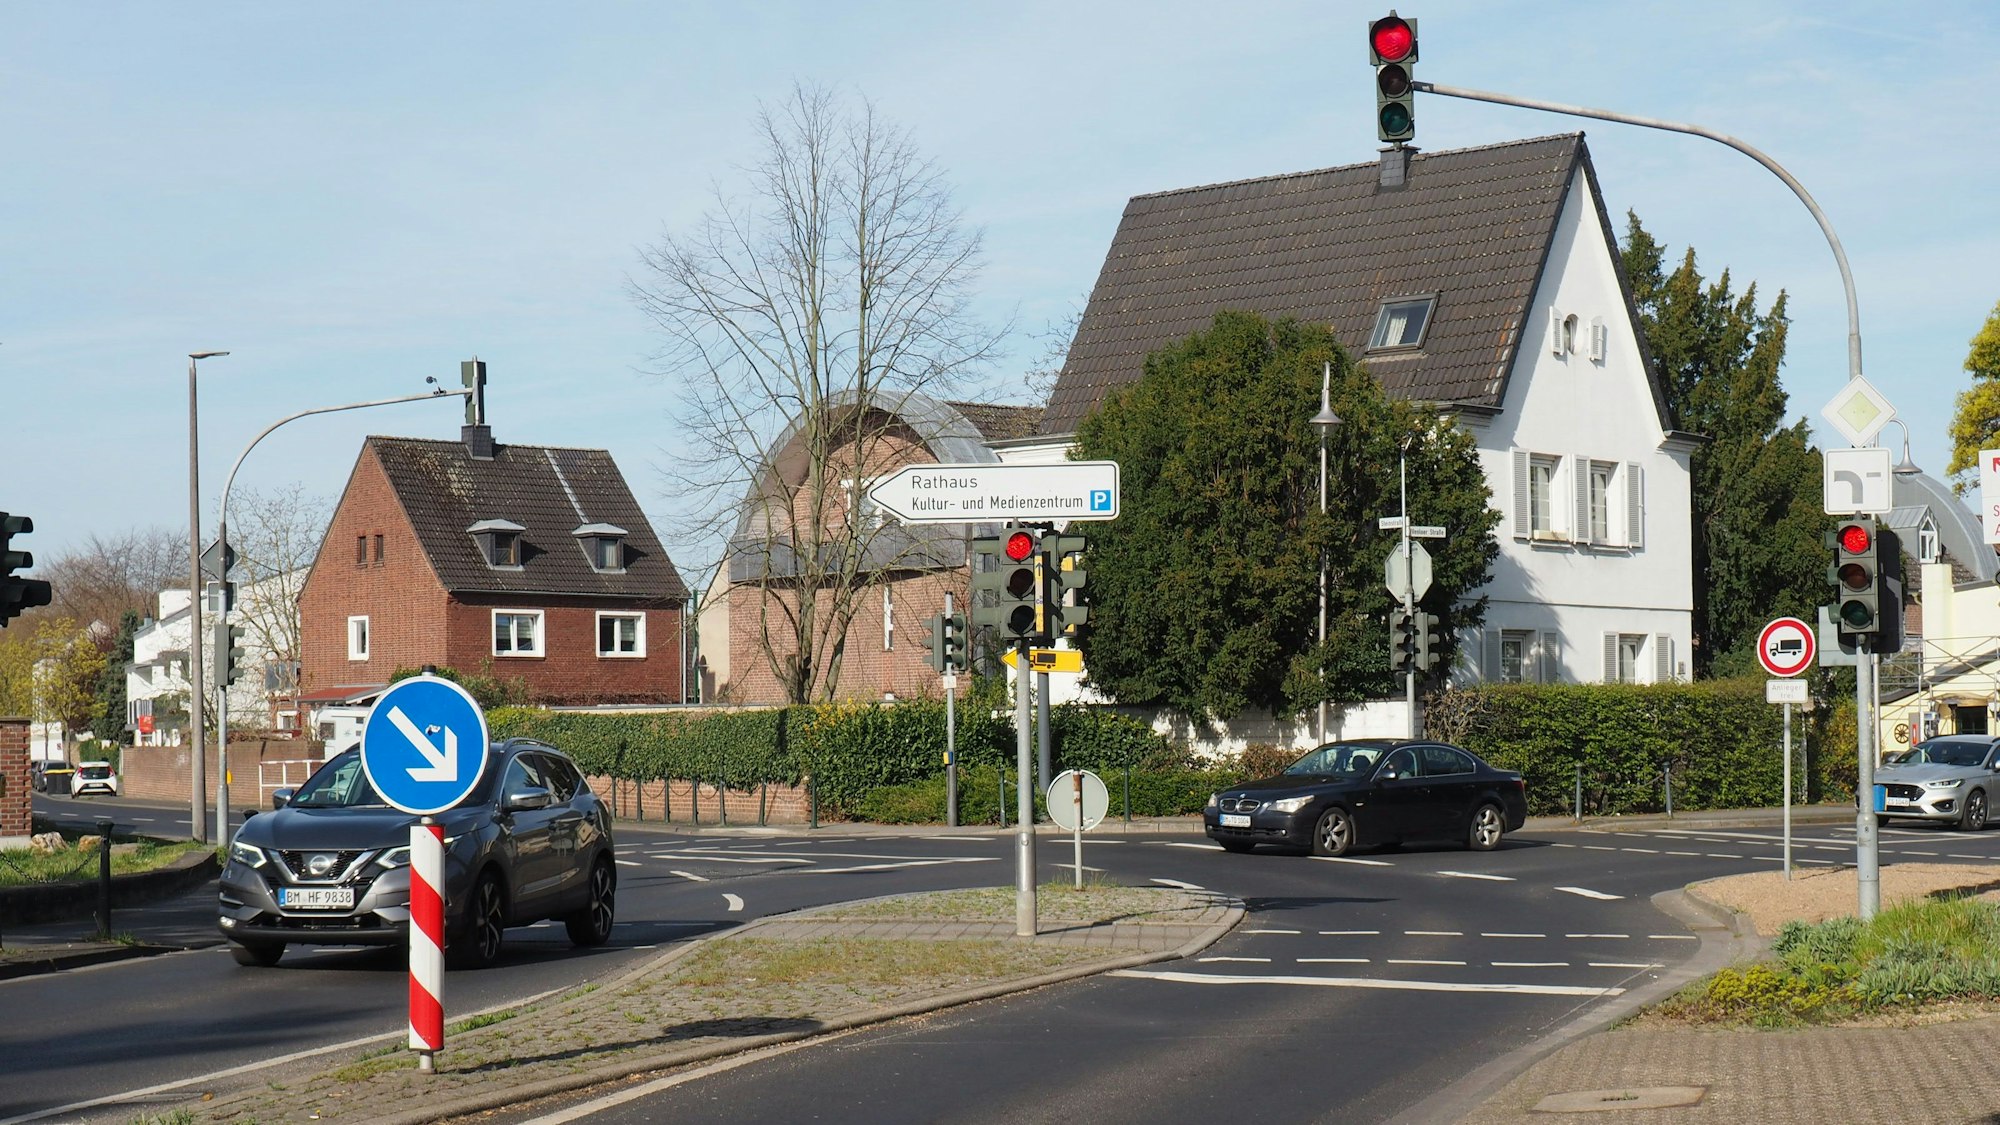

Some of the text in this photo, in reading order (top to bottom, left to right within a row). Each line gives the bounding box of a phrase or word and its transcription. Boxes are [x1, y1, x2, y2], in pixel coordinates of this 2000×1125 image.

[911, 475, 978, 489] Rathaus
[912, 495, 1083, 511] Kultur- und Medienzentrum
[1094, 492, 1107, 508] P
[1429, 528, 1444, 536] Straße
[1771, 684, 1802, 692] Anlieger
[286, 891, 352, 903] BM HF 9838
